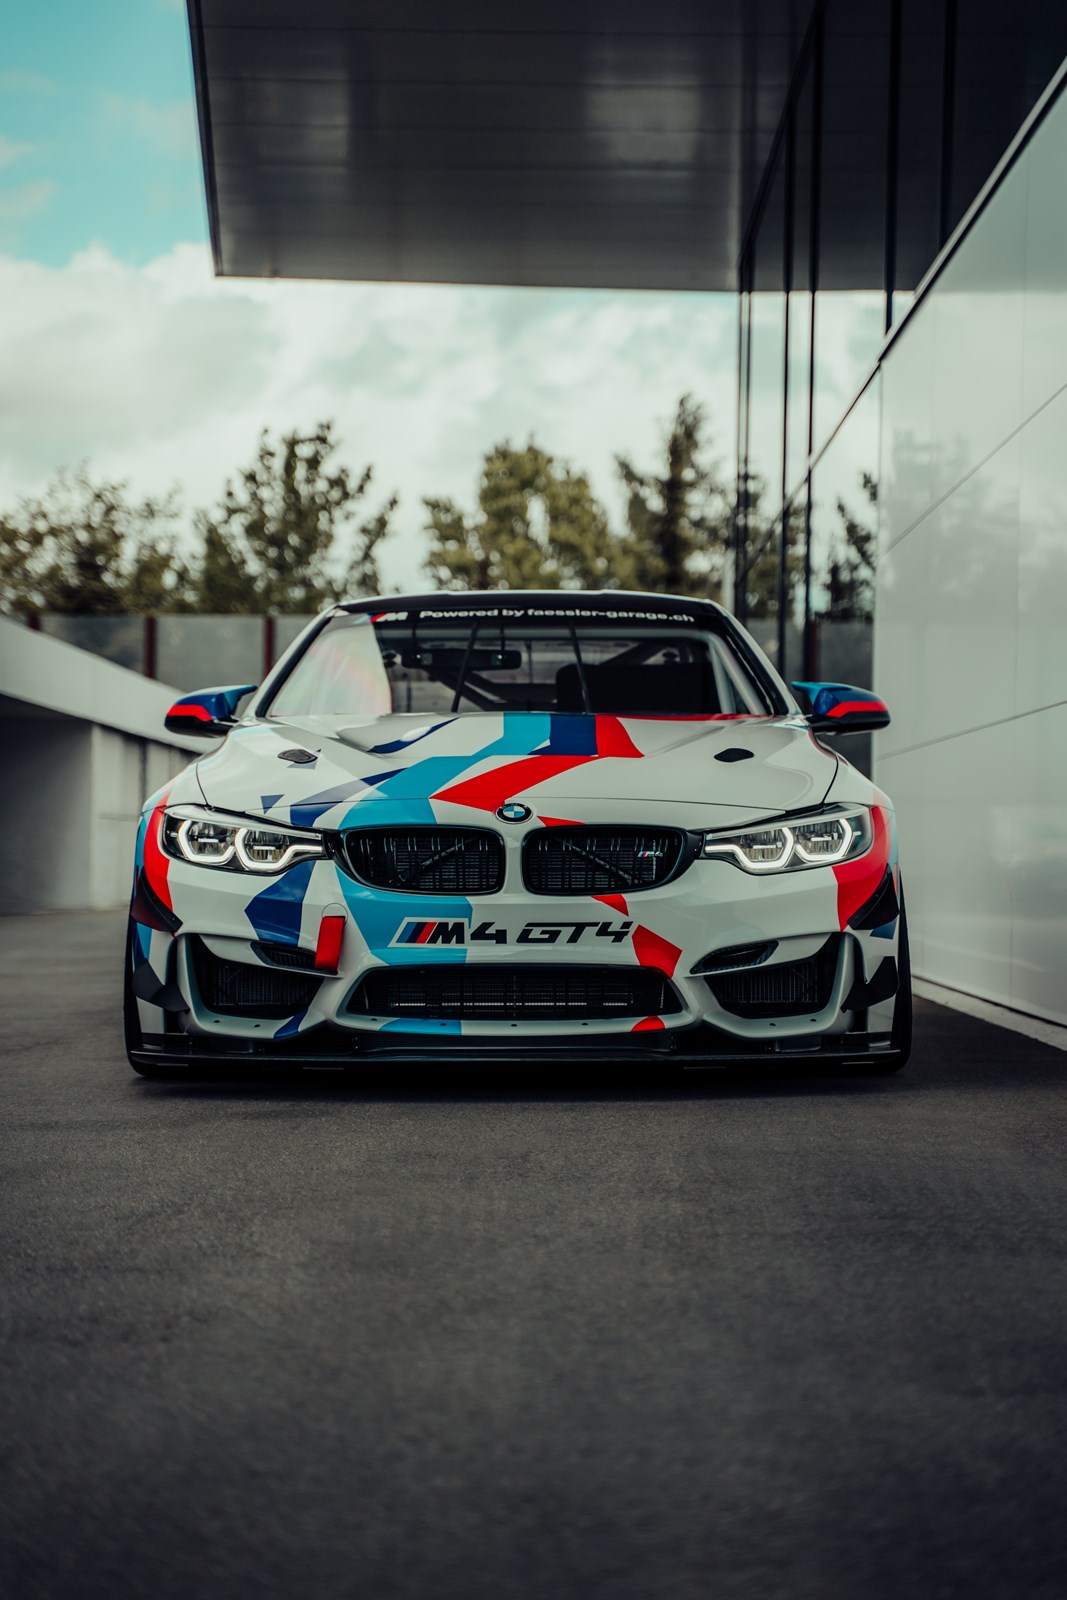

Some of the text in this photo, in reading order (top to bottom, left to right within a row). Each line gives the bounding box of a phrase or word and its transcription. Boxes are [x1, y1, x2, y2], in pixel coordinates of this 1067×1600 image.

[419, 609, 499, 618] Powered
[502, 609, 525, 617] by
[527, 609, 695, 622] faessler-garage.ch
[516, 920, 634, 944] GT4
